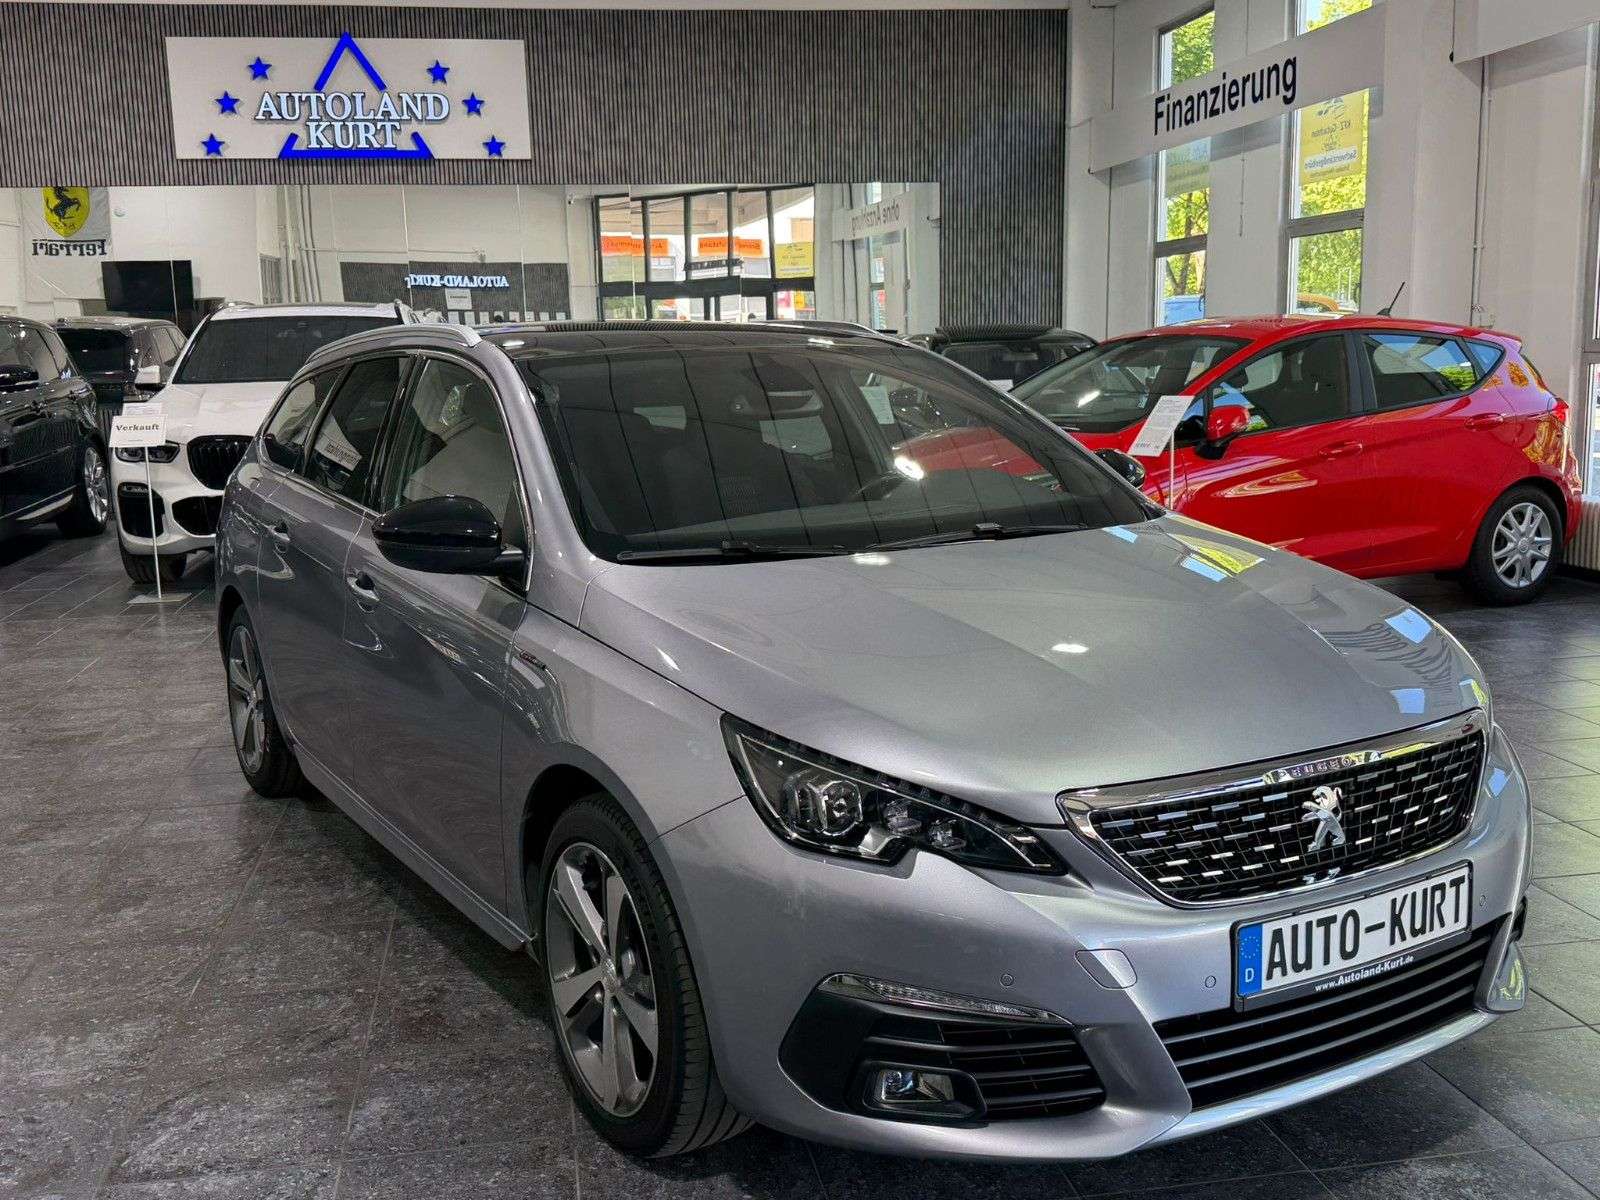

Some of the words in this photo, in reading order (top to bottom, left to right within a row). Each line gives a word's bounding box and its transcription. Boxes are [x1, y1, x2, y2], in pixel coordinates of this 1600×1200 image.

[255, 91, 450, 121] AUTOLAND
[1154, 55, 1298, 136] Finanzierung
[305, 121, 401, 149] KURT
[116, 422, 160, 431] Verkauft
[1265, 874, 1466, 981] AUTO-KURT
[1244, 967, 1255, 983] D
[1314, 955, 1414, 992] www.Autoland-Kurt.de
